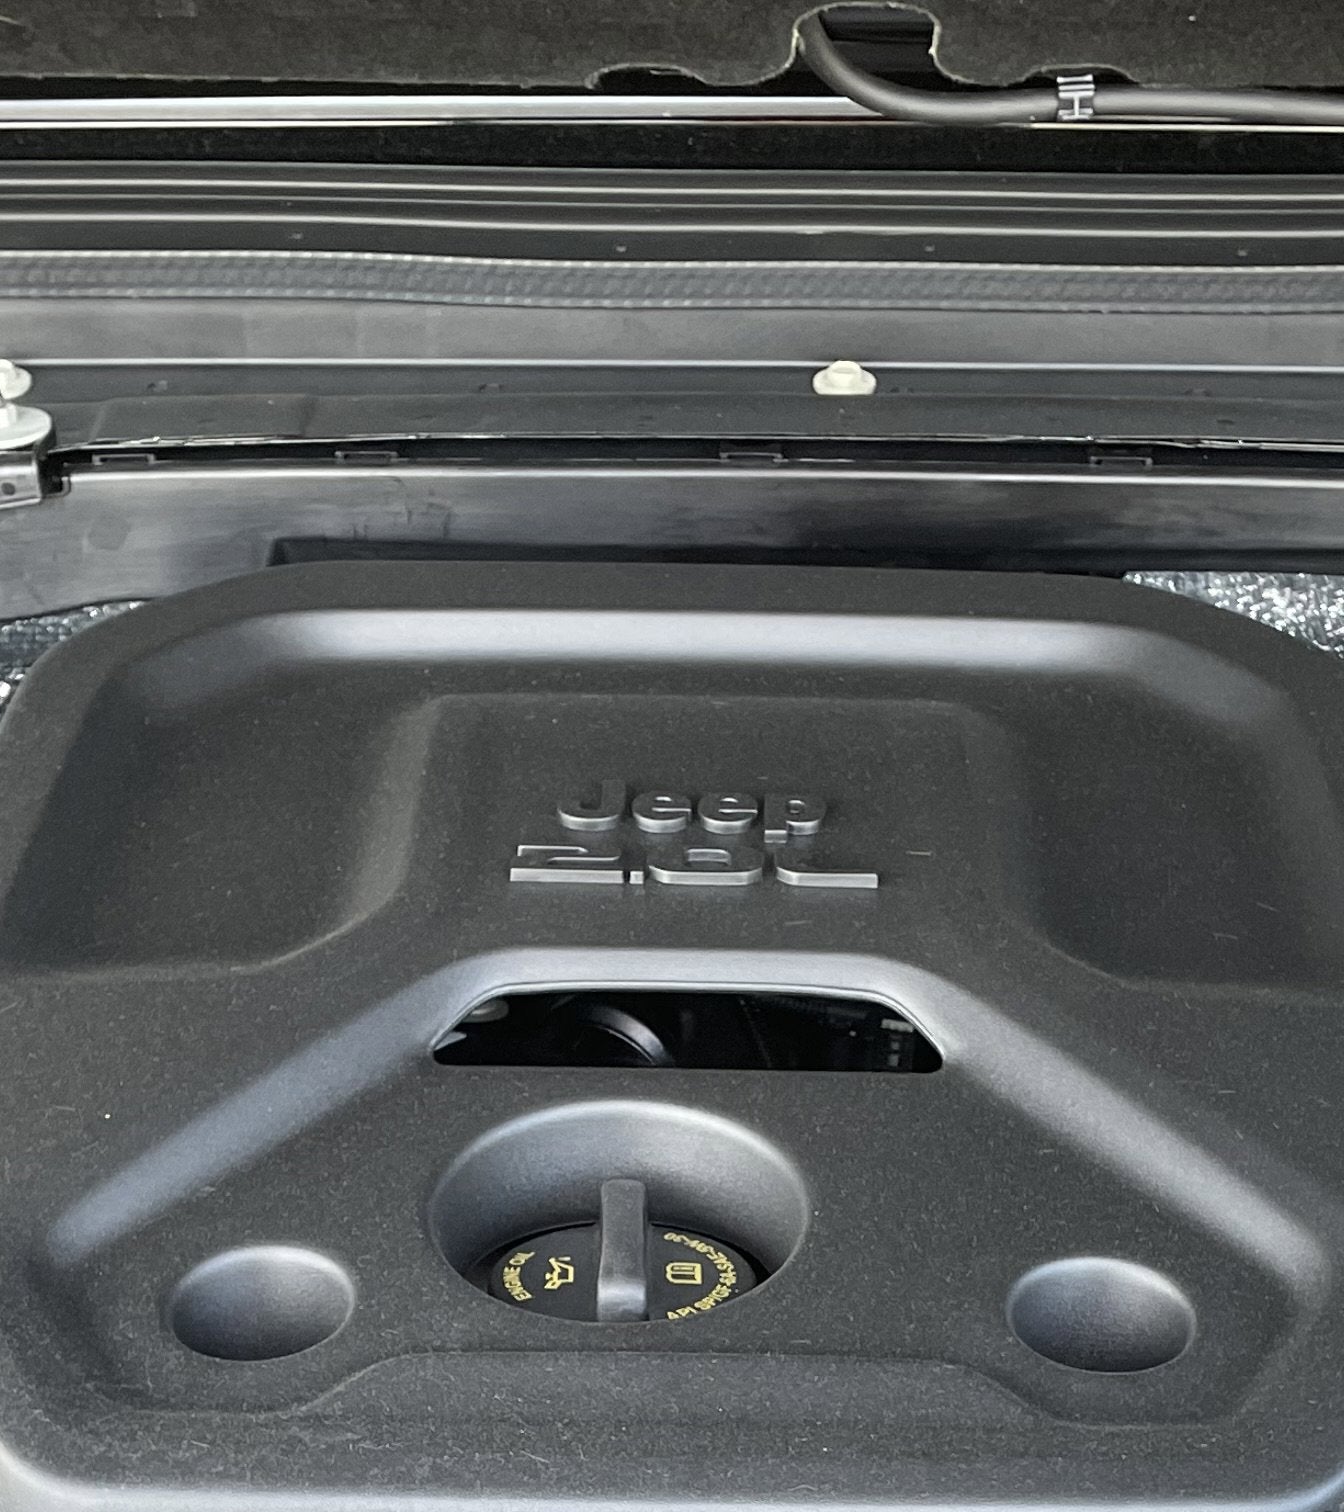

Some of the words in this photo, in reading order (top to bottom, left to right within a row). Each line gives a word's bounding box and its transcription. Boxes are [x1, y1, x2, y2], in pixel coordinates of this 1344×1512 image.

[556, 779, 825, 844] Jeep
[509, 844, 879, 888] 2.0L
[509, 1251, 536, 1265] OIL
[503, 1266, 533, 1301] ENGINE
[666, 1306, 697, 1320] API
